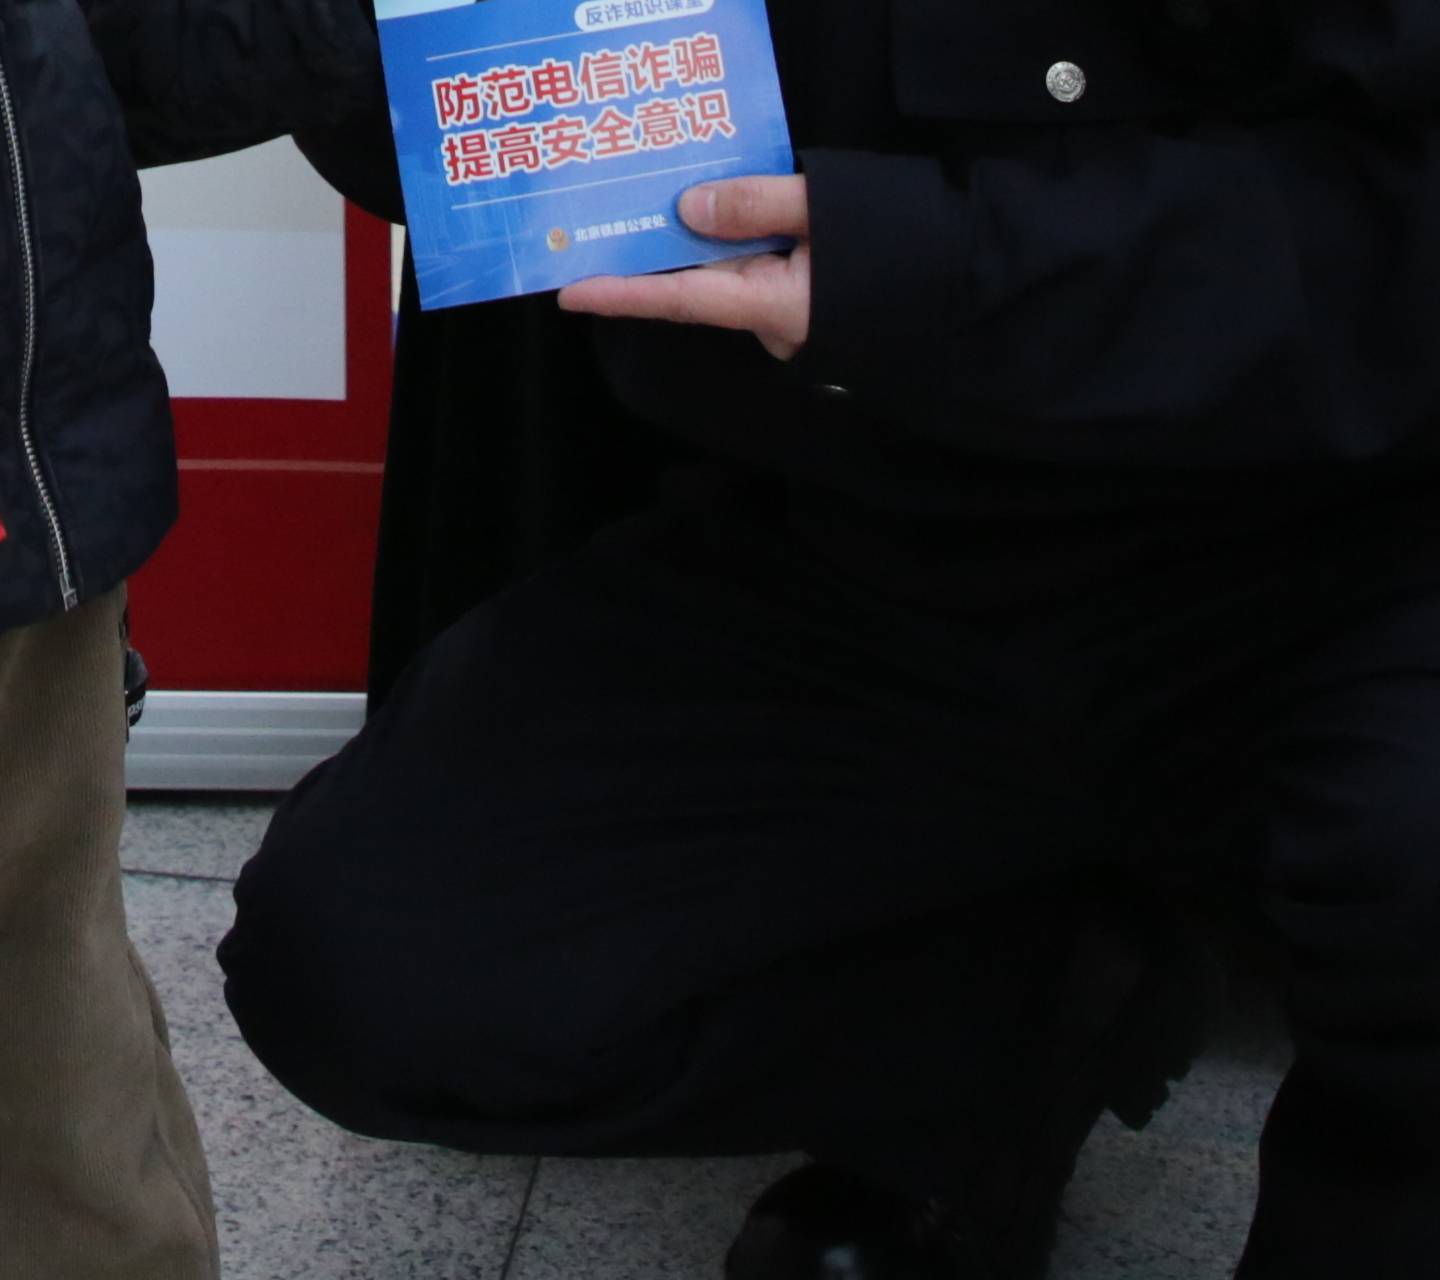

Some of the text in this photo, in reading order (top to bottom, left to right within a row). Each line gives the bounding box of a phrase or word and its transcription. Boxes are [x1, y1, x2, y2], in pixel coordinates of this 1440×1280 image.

[434, 32, 723, 127] 防范电信诈骗
[444, 90, 735, 184] 提高安全意识
